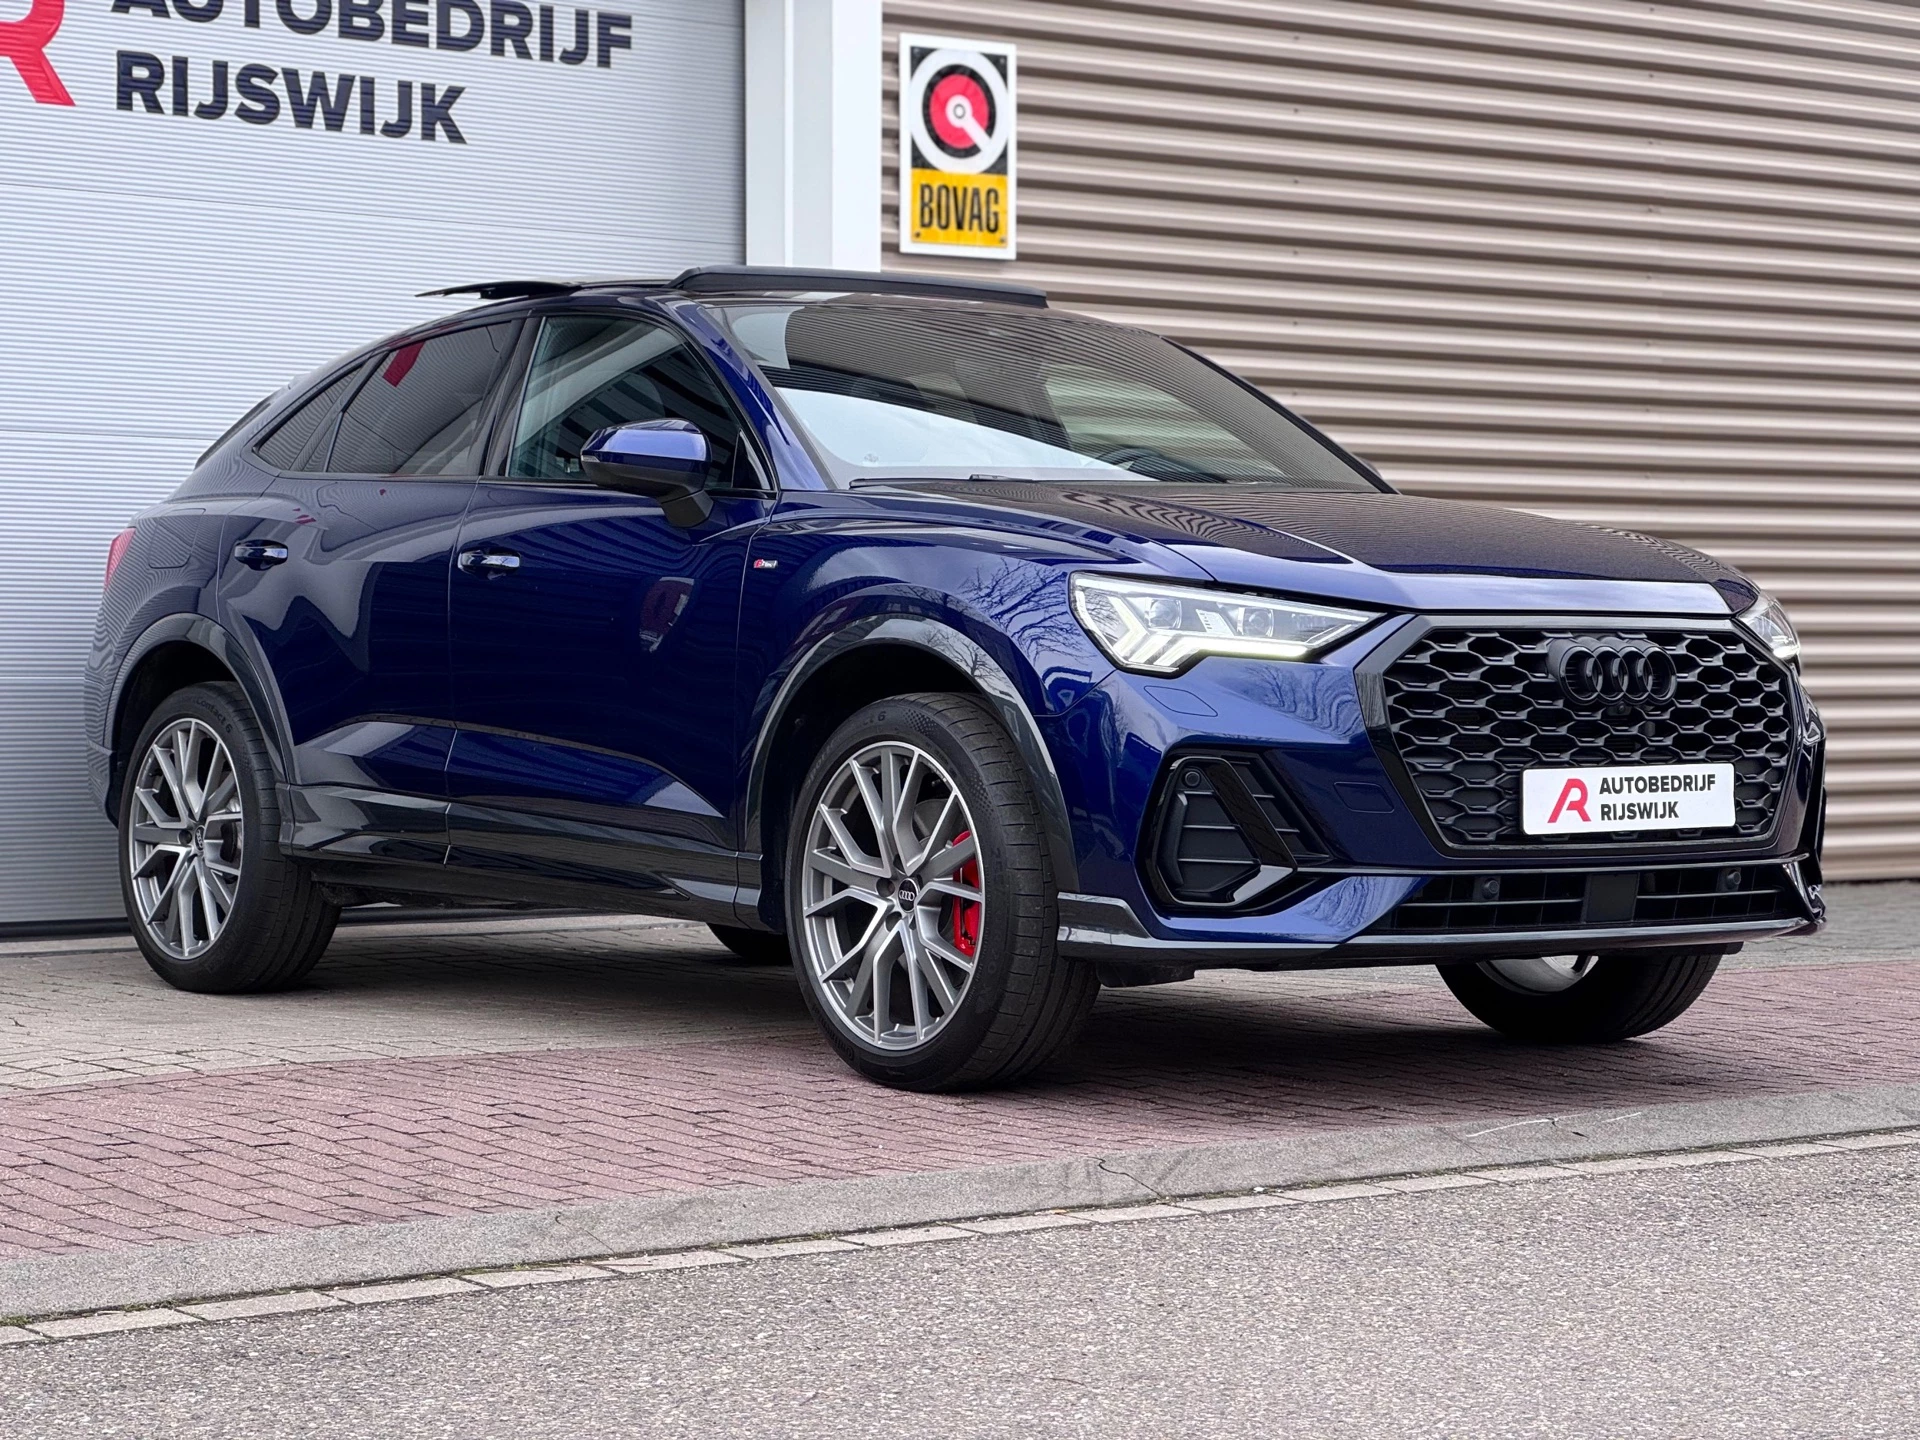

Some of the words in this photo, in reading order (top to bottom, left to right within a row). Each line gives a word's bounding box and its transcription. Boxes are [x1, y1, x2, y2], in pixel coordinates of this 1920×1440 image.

[116, 50, 467, 144] RIJSWIJK
[919, 183, 999, 233] BOVAG
[1599, 773, 1716, 795] AUTOBEDRIJF
[1600, 801, 1679, 821] RIJSWIJK
